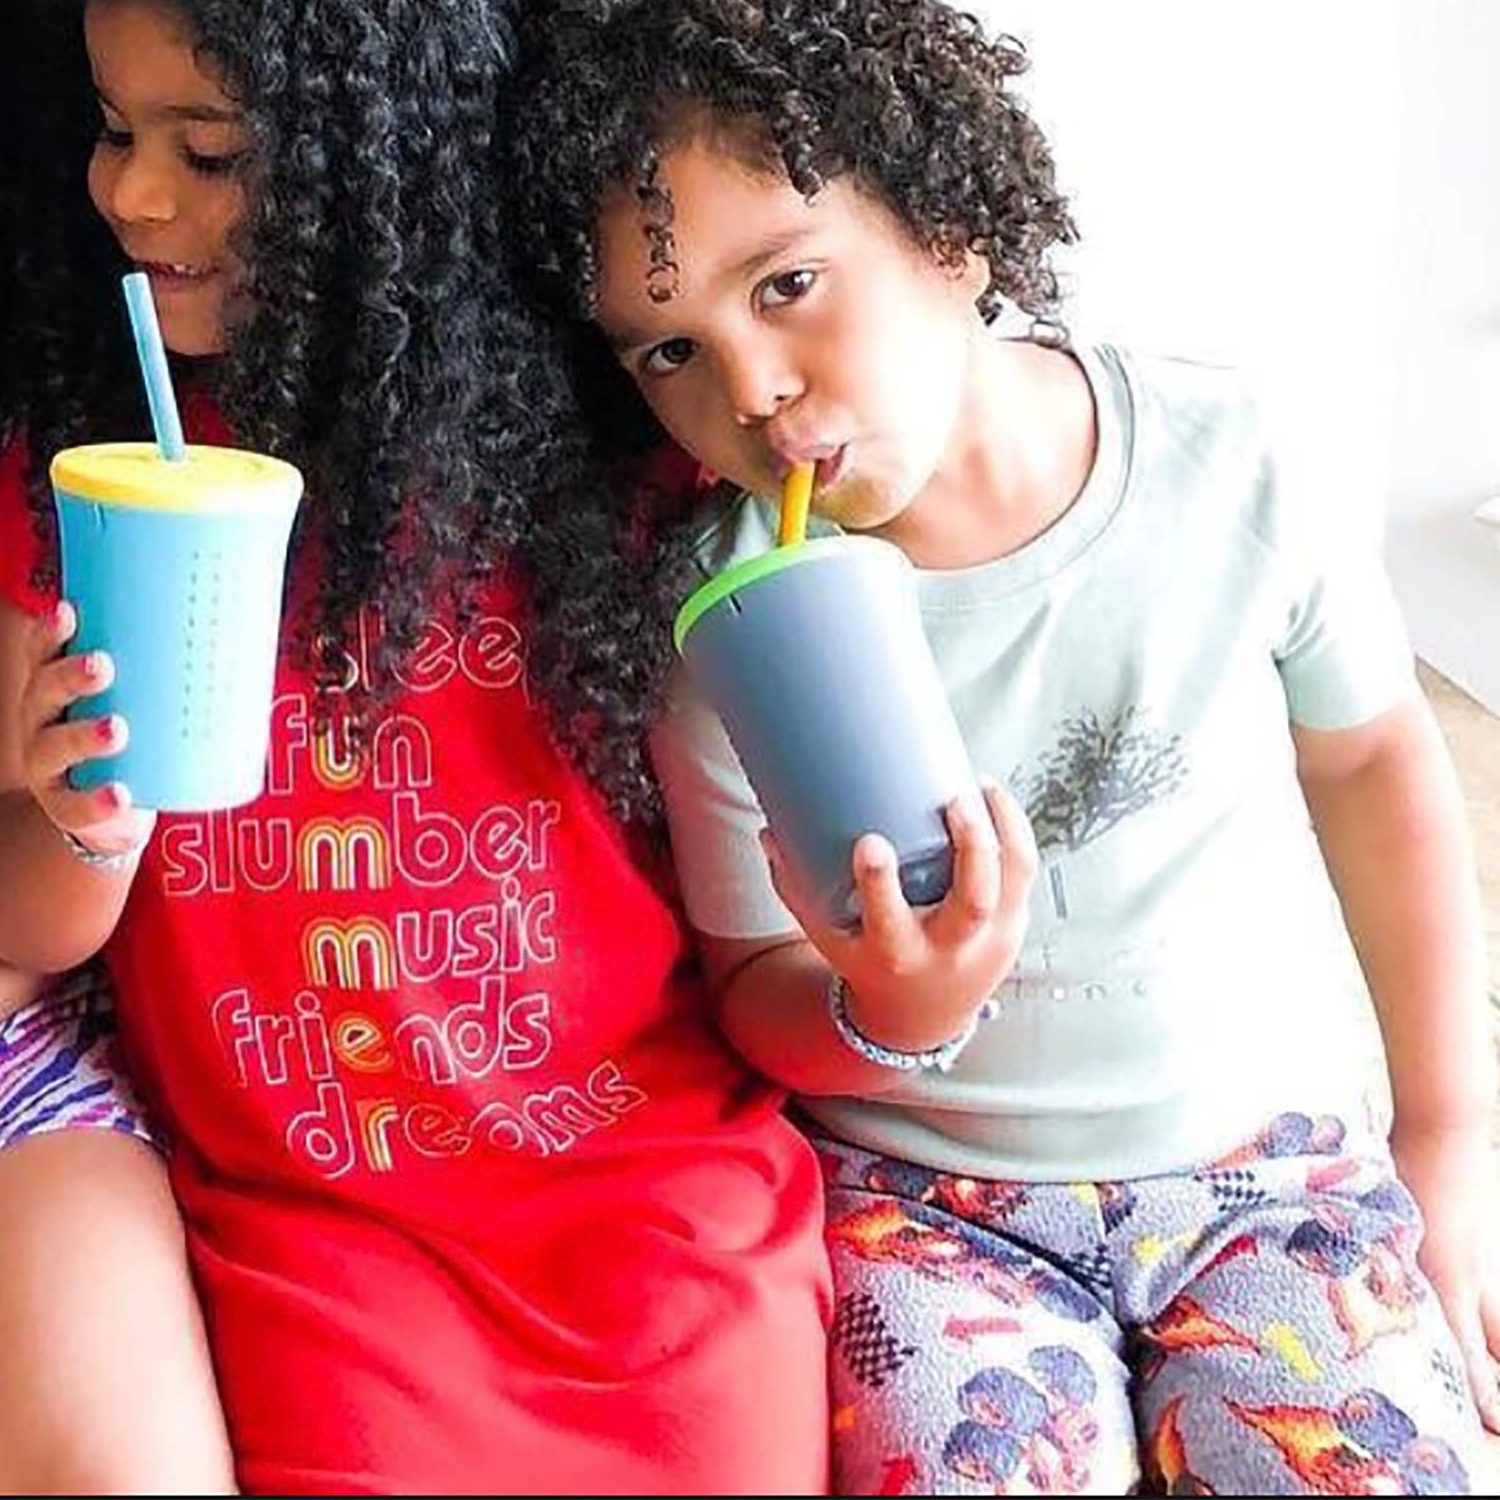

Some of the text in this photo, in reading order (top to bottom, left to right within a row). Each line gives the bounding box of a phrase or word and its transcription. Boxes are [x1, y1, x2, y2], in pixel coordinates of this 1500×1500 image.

[267, 694, 432, 796] fun
[162, 790, 561, 898] slumber
[302, 876, 555, 991] music
[212, 976, 553, 1088] friends
[286, 1060, 648, 1180] dreams
